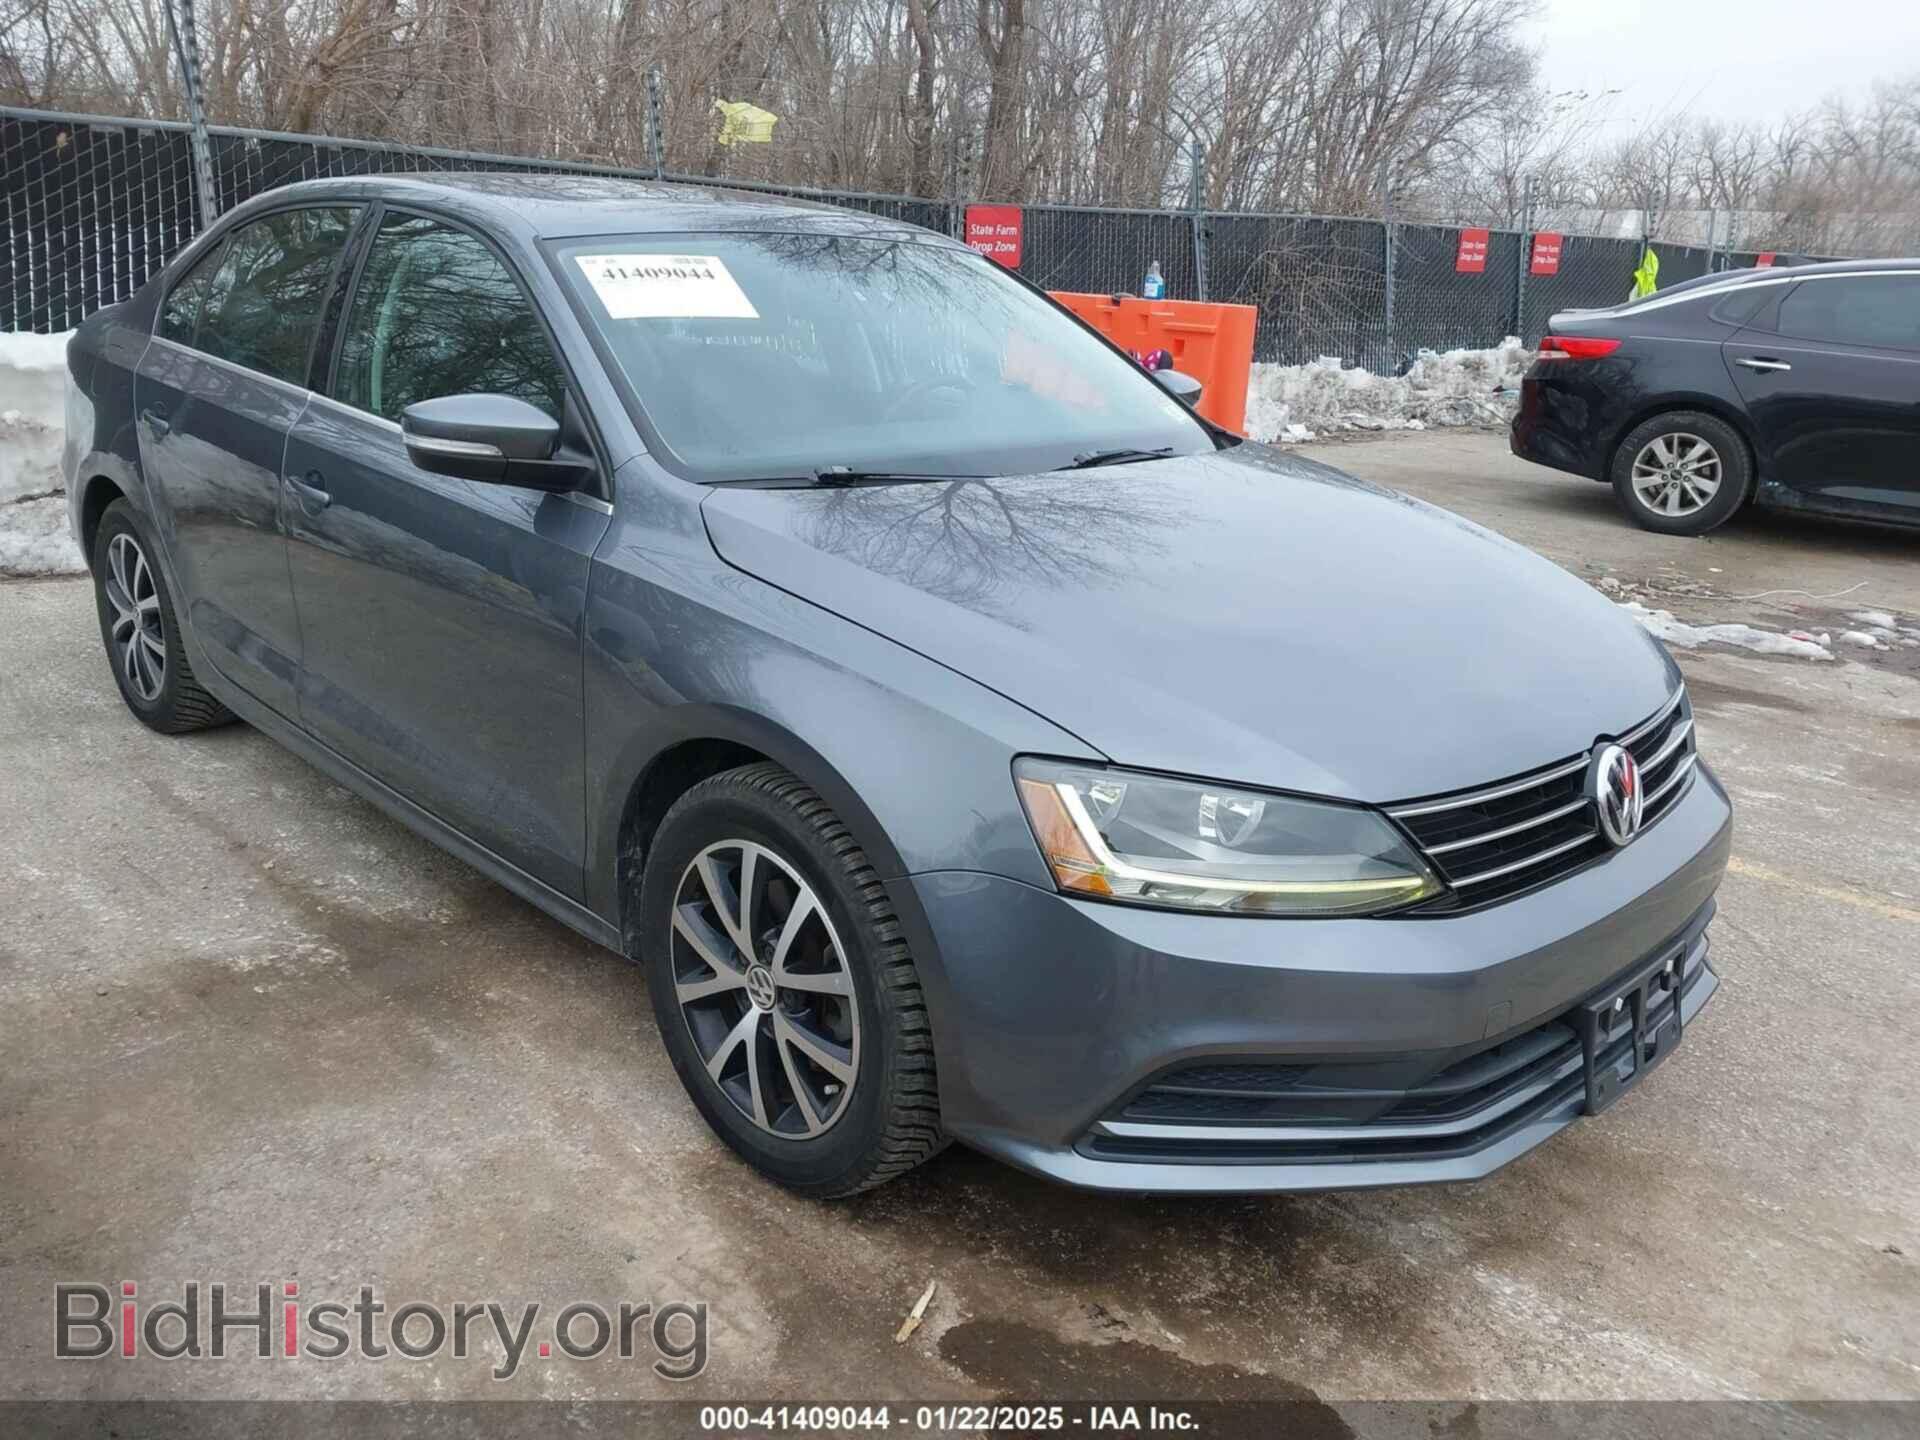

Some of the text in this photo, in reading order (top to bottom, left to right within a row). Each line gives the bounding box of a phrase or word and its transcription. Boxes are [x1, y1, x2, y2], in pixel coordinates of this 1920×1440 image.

[970, 224, 1017, 236] State Farm
[971, 240, 1017, 254] Drop Zone
[602, 267, 715, 280] 41409044
